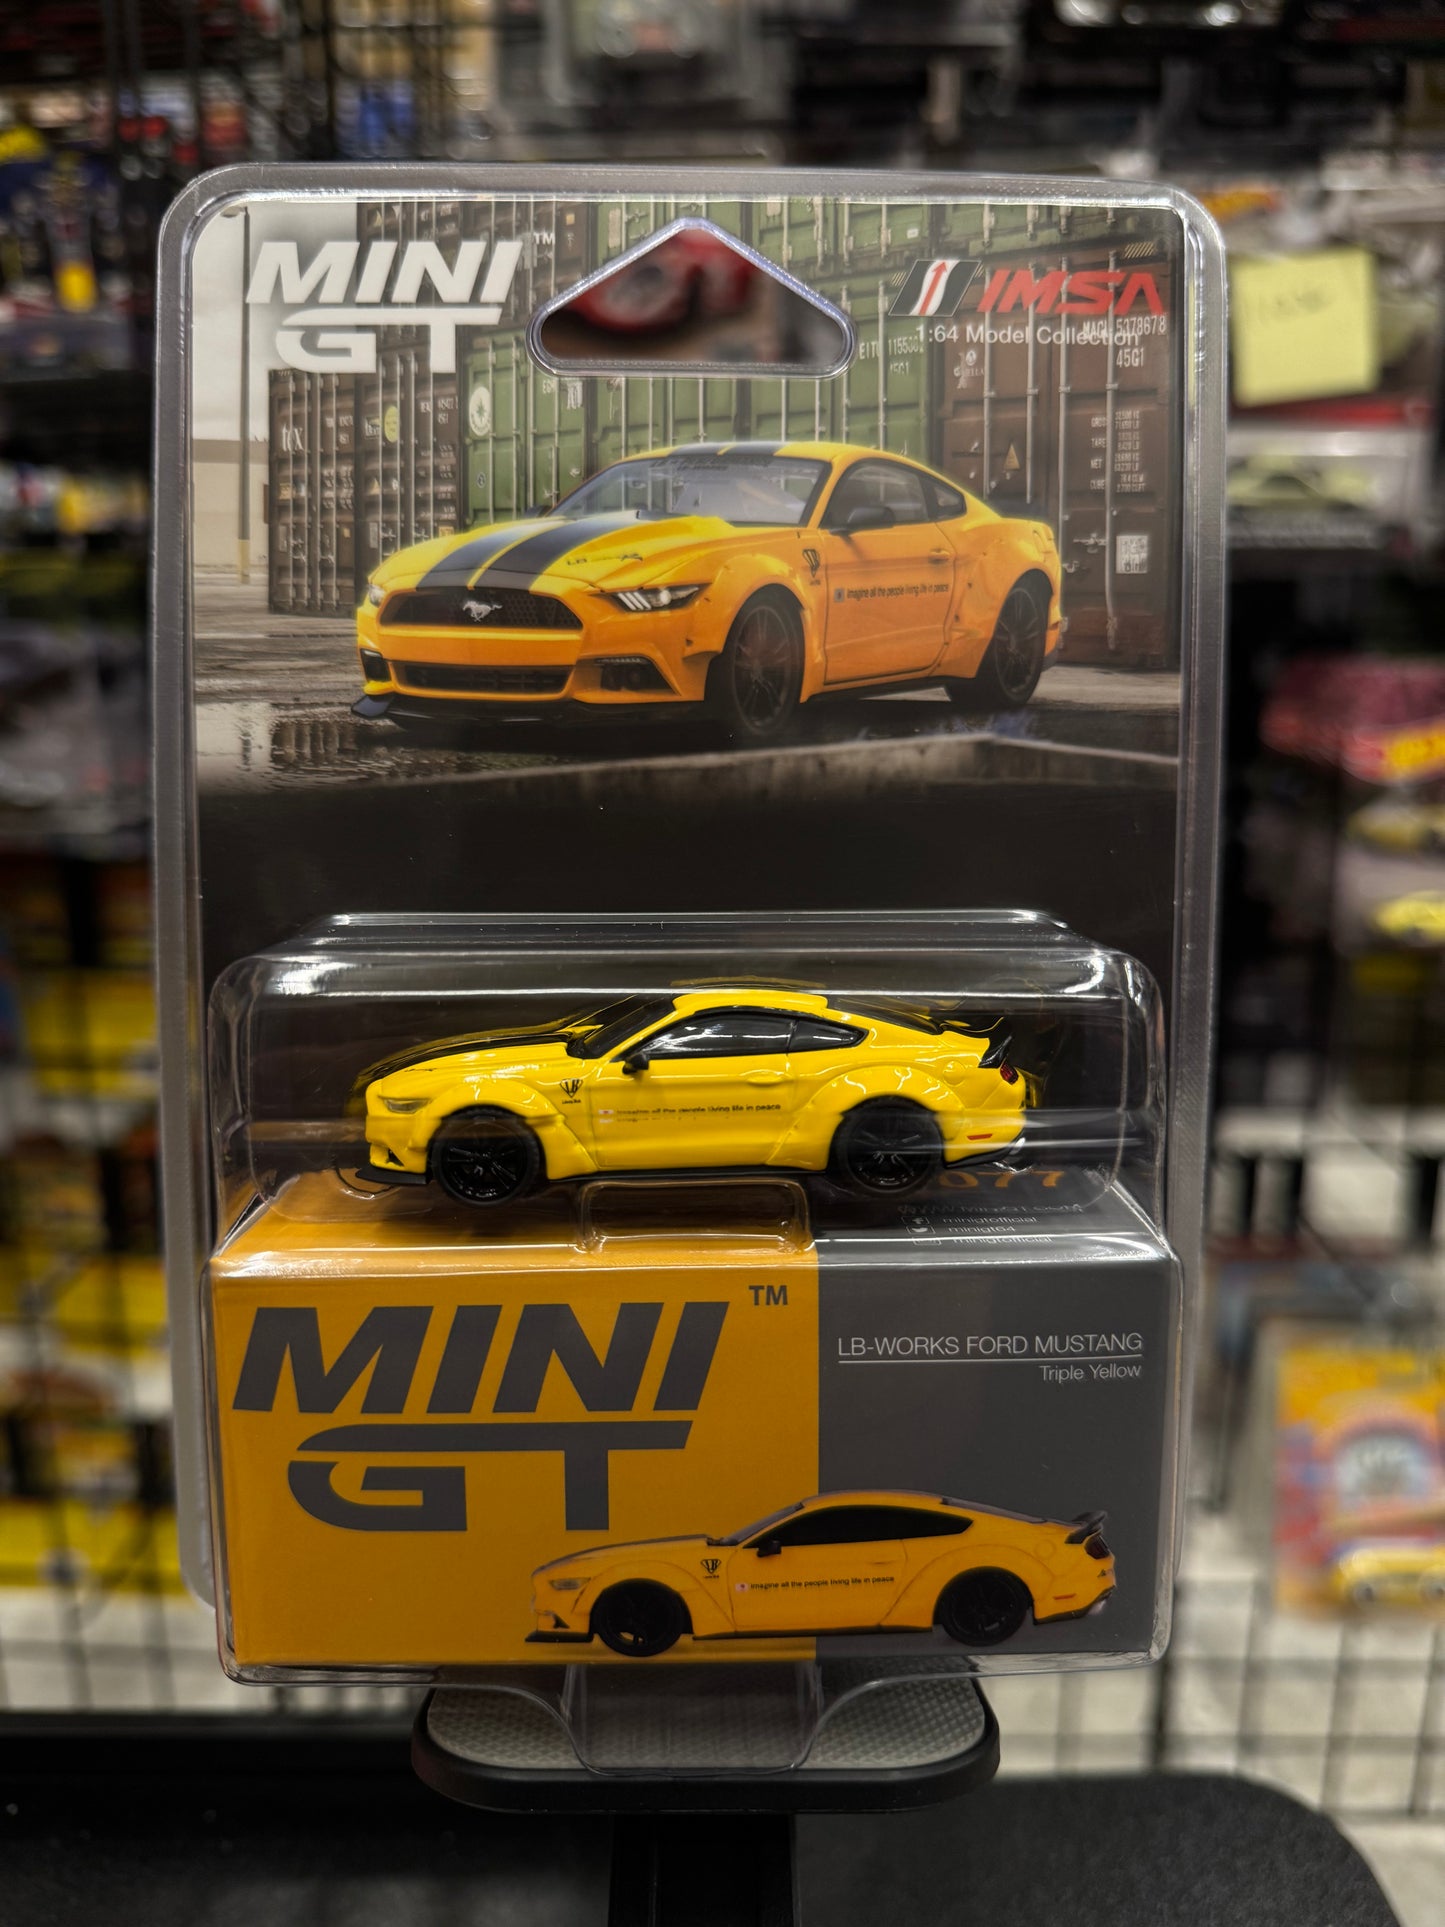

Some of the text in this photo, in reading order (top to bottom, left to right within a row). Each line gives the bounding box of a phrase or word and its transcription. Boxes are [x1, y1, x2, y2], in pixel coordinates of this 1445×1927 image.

[245, 241, 523, 304] MINI
[977, 268, 1165, 315] IMSA
[275, 307, 503, 374] GT
[916, 323, 1139, 347] 1:64 Model Collection
[755, 1102, 782, 1113] peace
[232, 1285, 789, 1414] MINI TM
[837, 1332, 1143, 1356] LB-WORKS FORD MUSTANG
[1039, 1364, 1142, 1384] Triple Yellow
[287, 1420, 694, 1532] GT
[791, 1580, 803, 1588] the
[803, 1579, 829, 1588] people
[871, 1576, 894, 1585] peace
